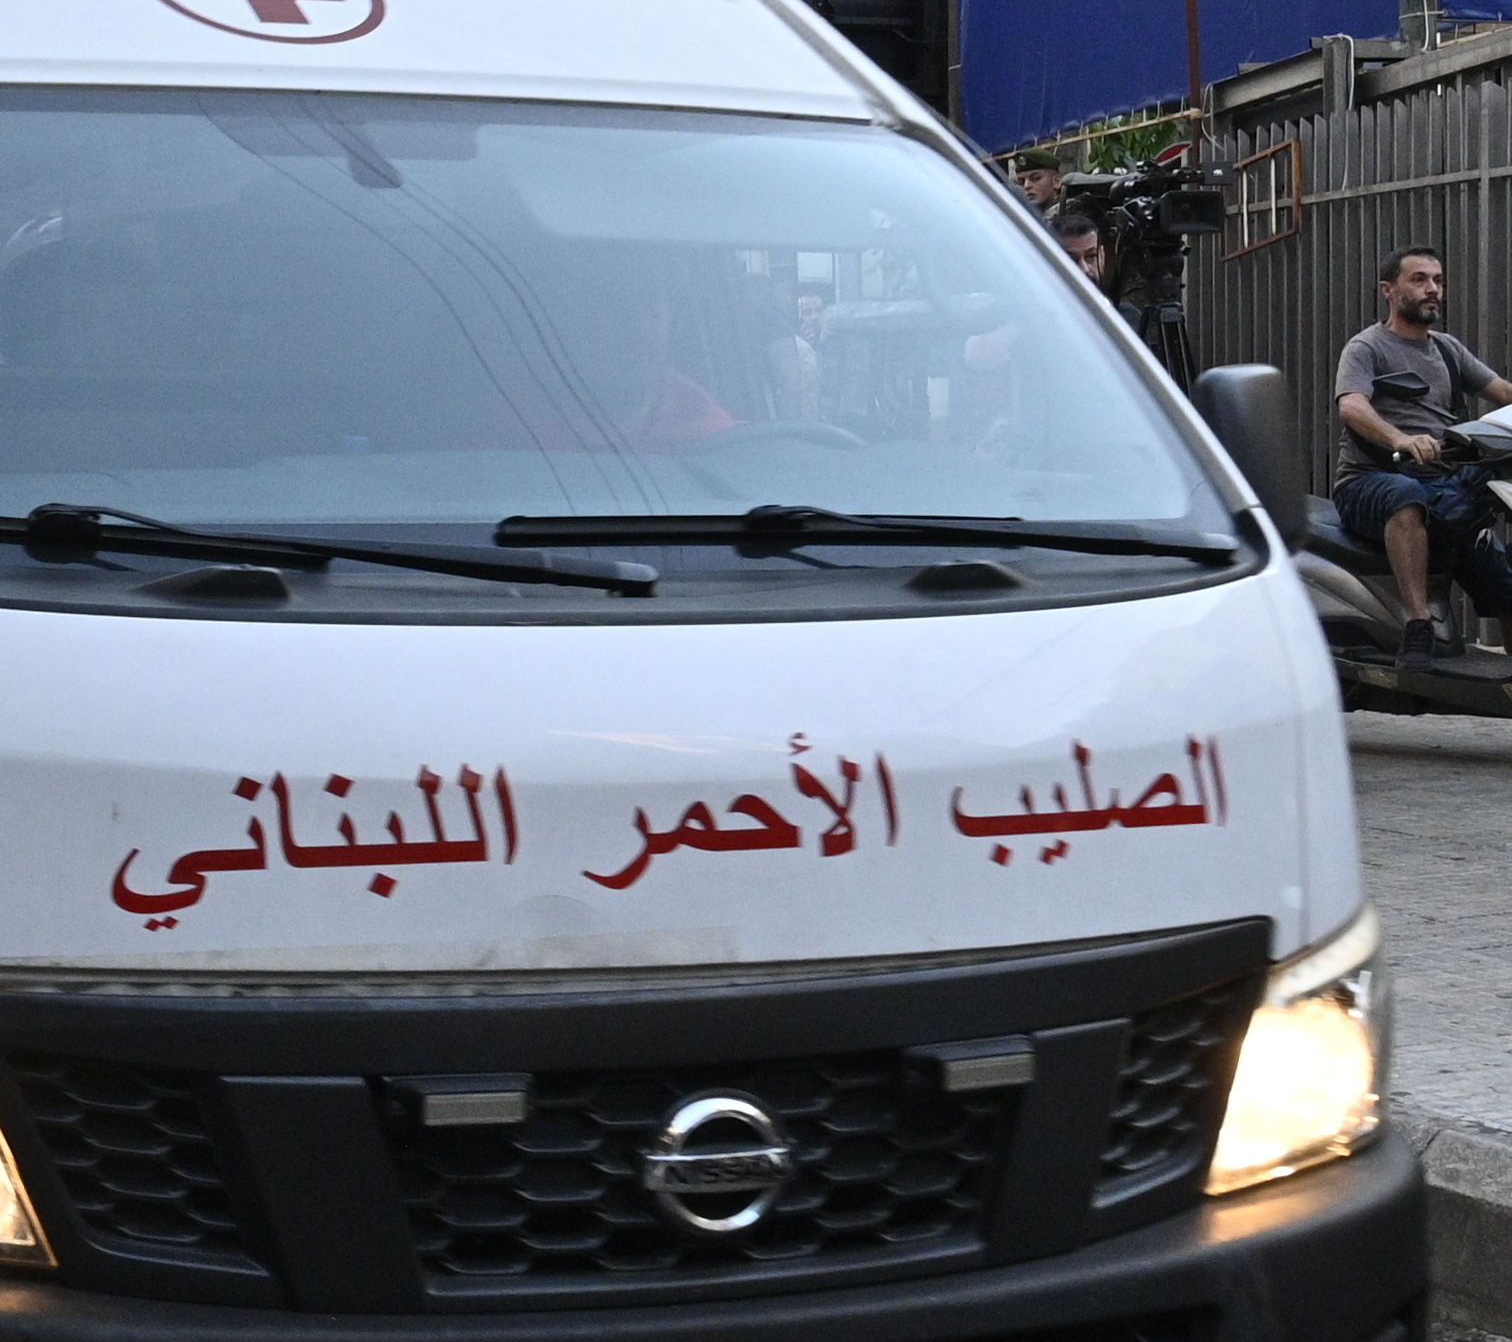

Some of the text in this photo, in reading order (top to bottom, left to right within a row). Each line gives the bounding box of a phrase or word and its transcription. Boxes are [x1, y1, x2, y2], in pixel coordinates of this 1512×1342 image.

[109, 732, 1228, 932] الصليب الأحمر اللبناني
